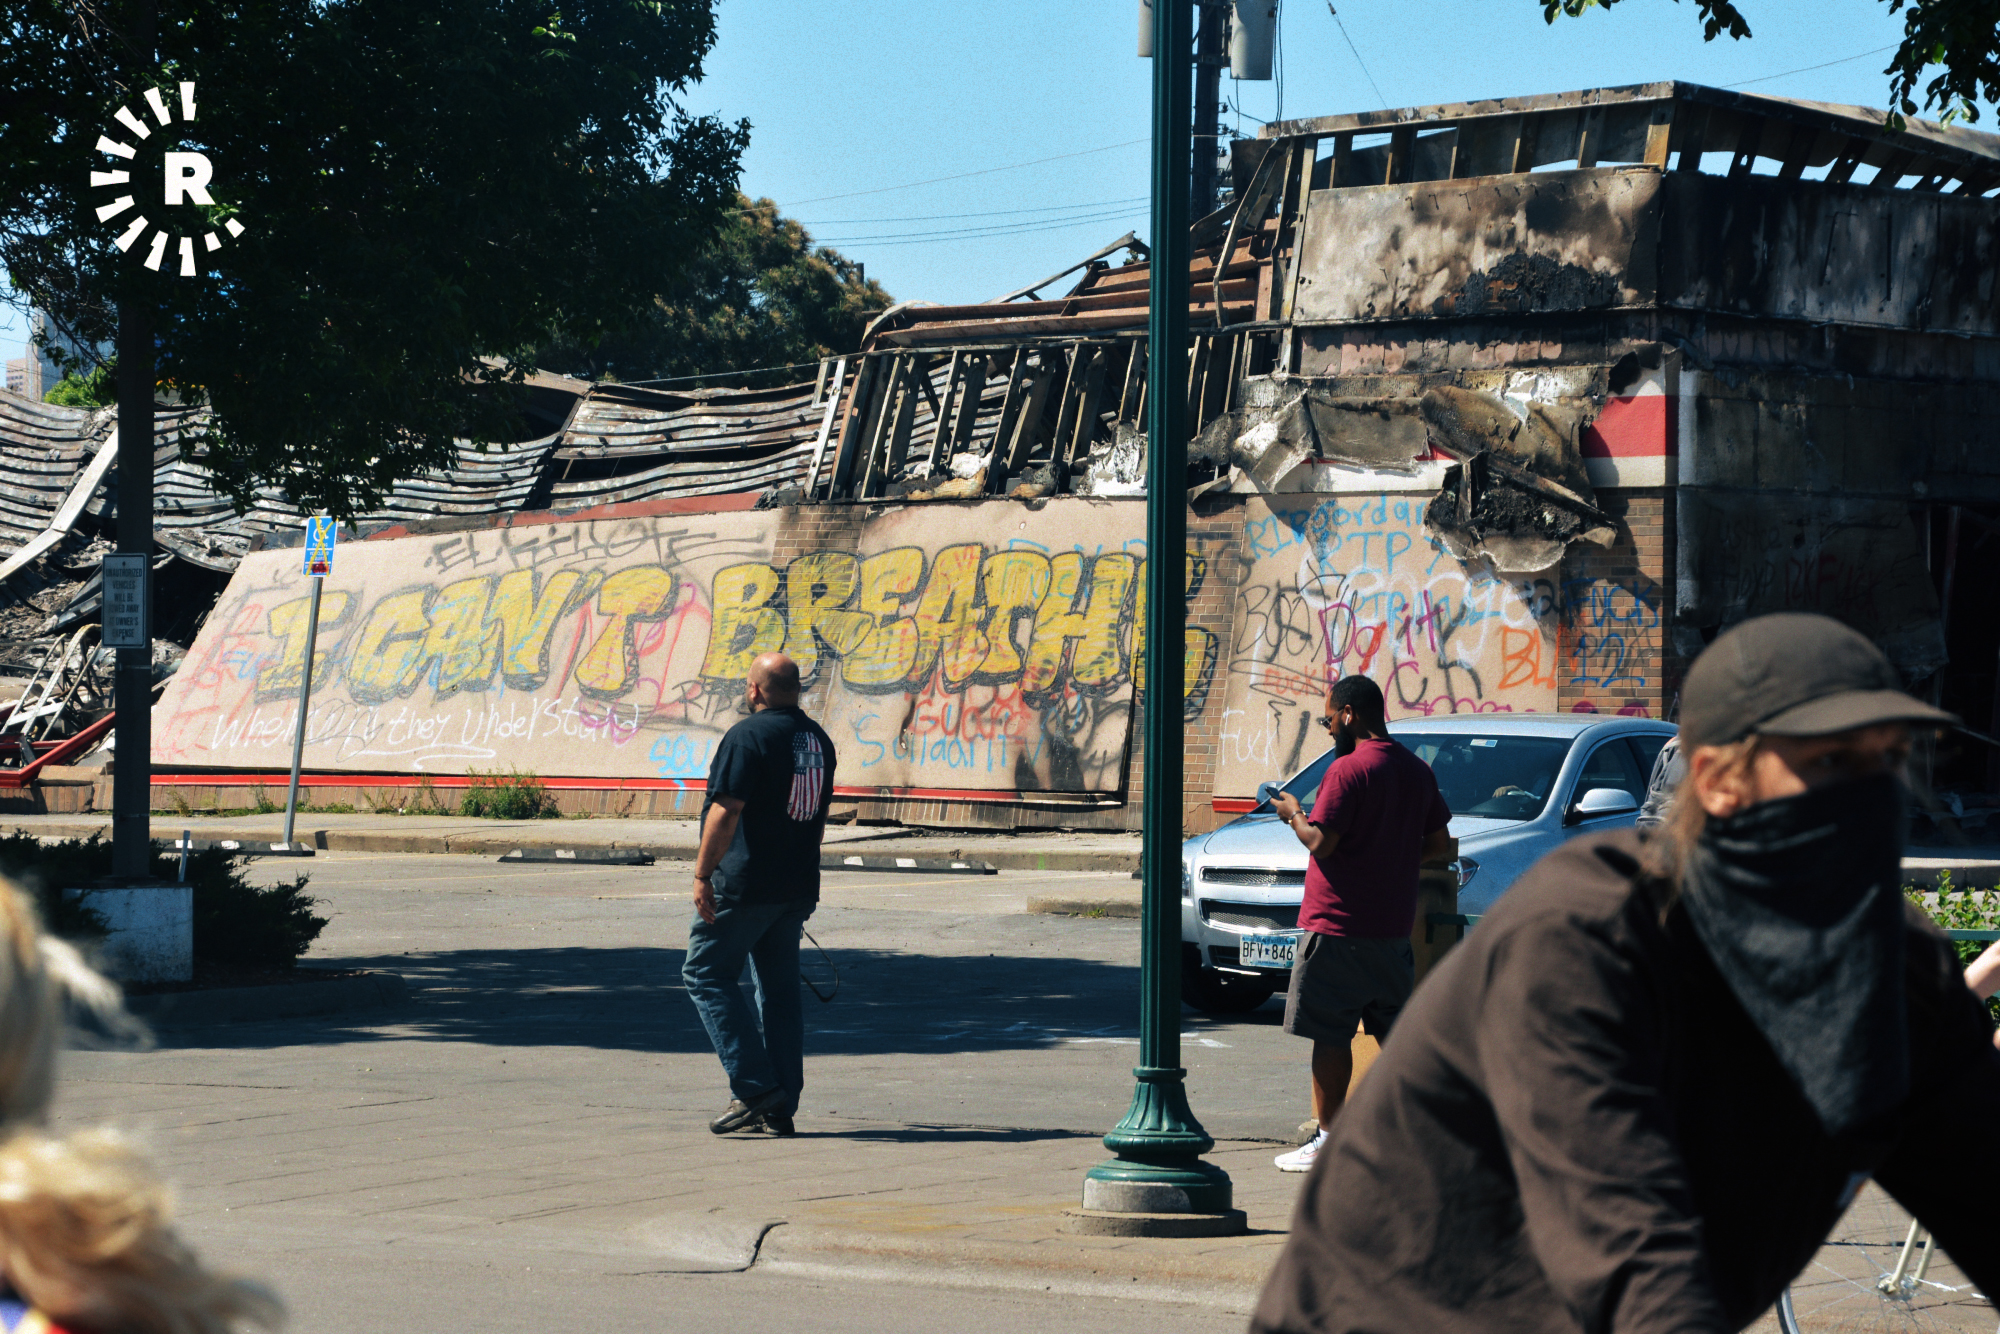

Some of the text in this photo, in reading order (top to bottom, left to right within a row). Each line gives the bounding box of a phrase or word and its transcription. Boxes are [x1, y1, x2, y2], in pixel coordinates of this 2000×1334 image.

[105, 568, 142, 577] UNAUTHORIZED
[112, 580, 136, 589] VEHICLES
[114, 593, 134, 602] WILL BE
[1562, 576, 1660, 628] FUCK
[126, 604, 139, 613] AWAY
[115, 617, 139, 626] OWNER'S
[112, 628, 135, 637] EXPENSE
[1571, 633, 1646, 688] 12
[387, 706, 452, 747] they
[1242, 941, 1294, 961] BFV 846
